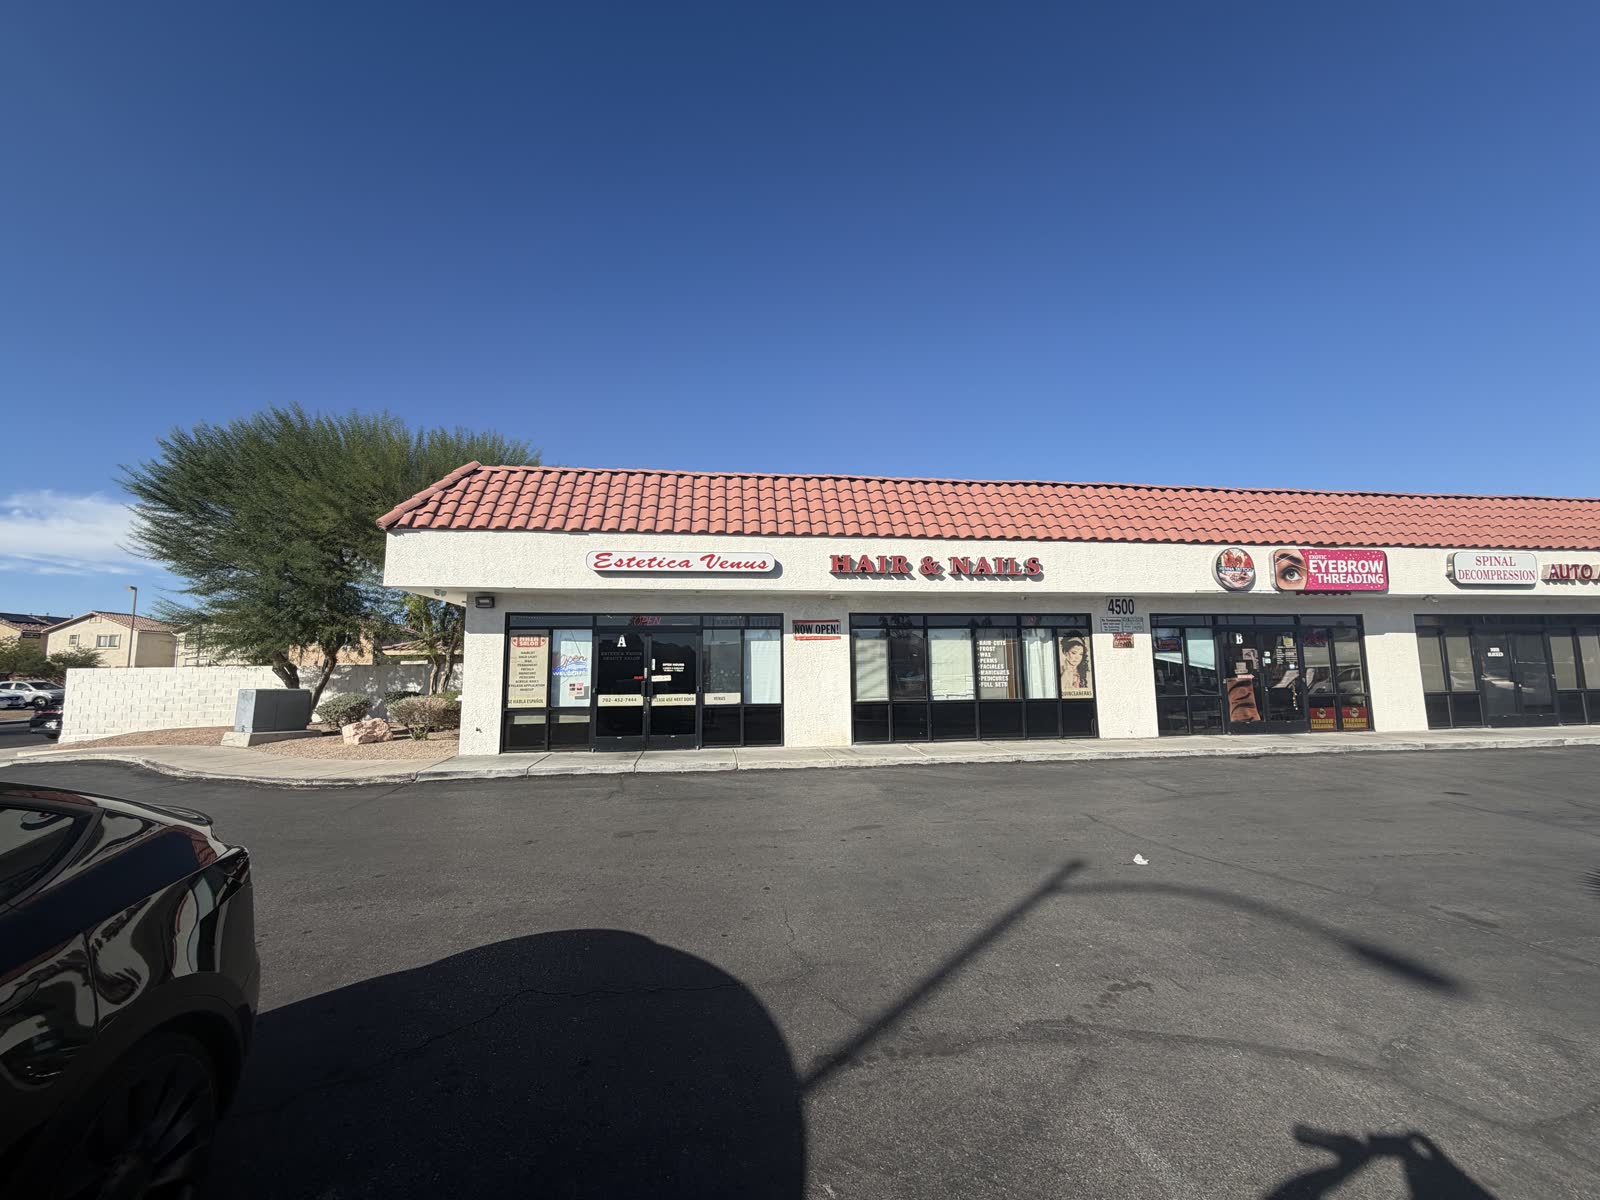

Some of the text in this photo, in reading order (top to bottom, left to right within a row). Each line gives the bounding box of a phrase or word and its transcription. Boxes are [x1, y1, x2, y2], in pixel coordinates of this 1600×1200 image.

[593, 552, 769, 570] Estetica Venus
[830, 554, 1041, 576] HAIR & NAILS
[1308, 560, 1384, 573] EYEBROW
[1475, 556, 1516, 567] SPINAL
[1458, 569, 1536, 581] DECOMPRESSION
[1549, 563, 1593, 580] AUTO
[1315, 573, 1385, 585] THREADING
[1107, 598, 1135, 615] 4500
[794, 623, 839, 635] NOW OPEN!
[617, 634, 627, 648] A
[1235, 633, 1244, 645] B
